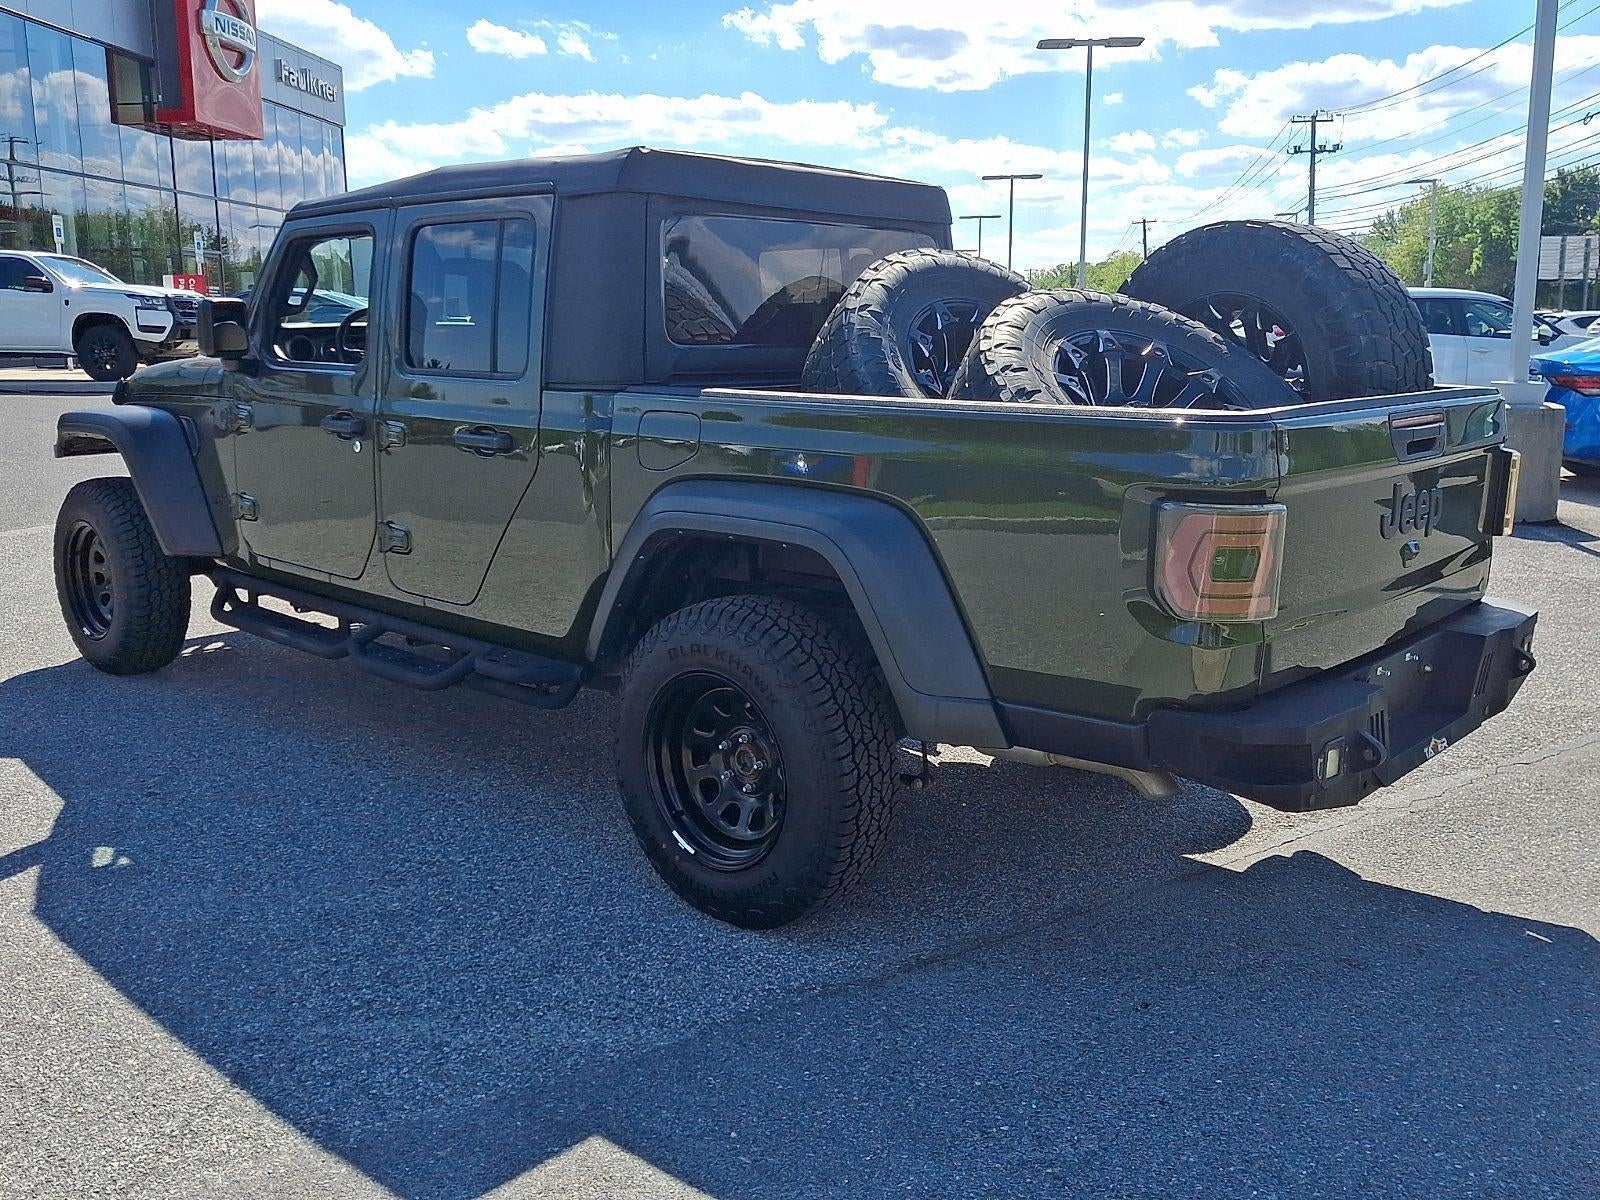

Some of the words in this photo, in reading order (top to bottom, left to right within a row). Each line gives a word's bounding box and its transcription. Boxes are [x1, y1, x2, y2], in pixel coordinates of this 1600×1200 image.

[214, 16, 256, 46] NISSAN
[276, 58, 338, 102] Faulkner
[1380, 482, 1443, 539] Jeep
